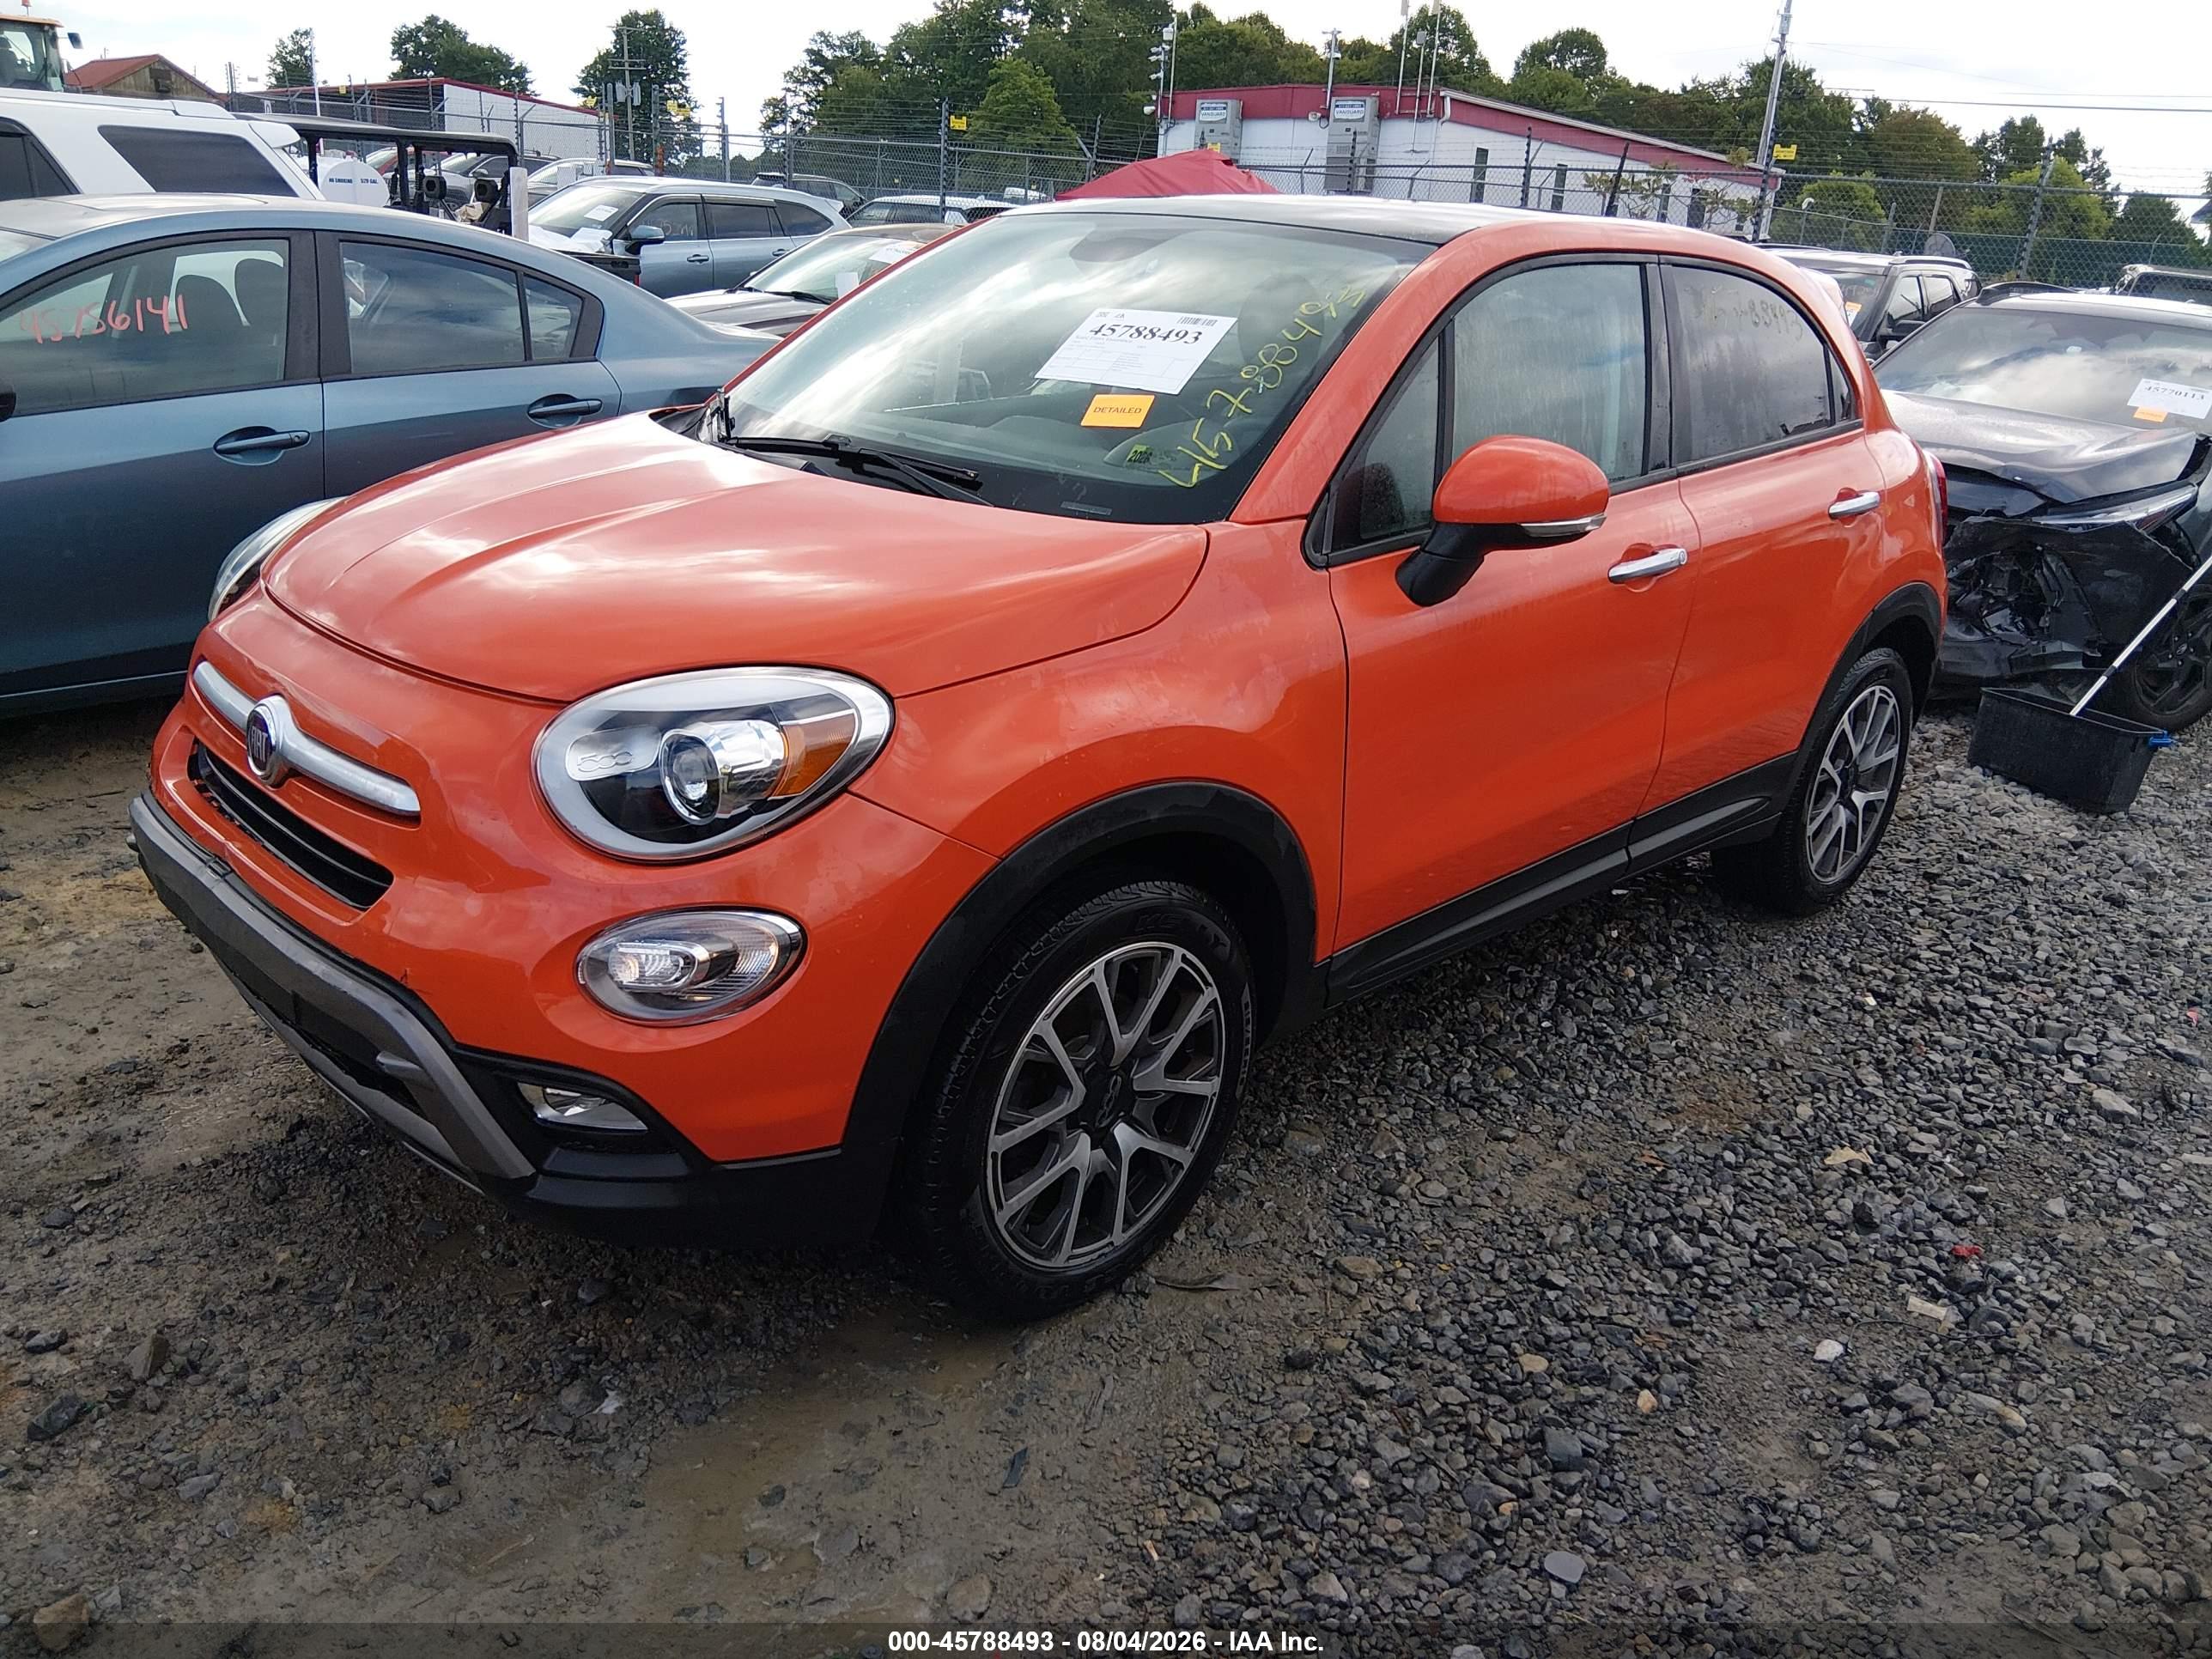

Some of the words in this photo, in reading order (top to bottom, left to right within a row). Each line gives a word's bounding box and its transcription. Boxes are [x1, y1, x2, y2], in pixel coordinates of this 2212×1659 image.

[20, 294, 188, 344] 45756141
[1089, 323, 1203, 344] 45788493
[250, 726, 268, 763] FIAT
[577, 752, 632, 772] 500
